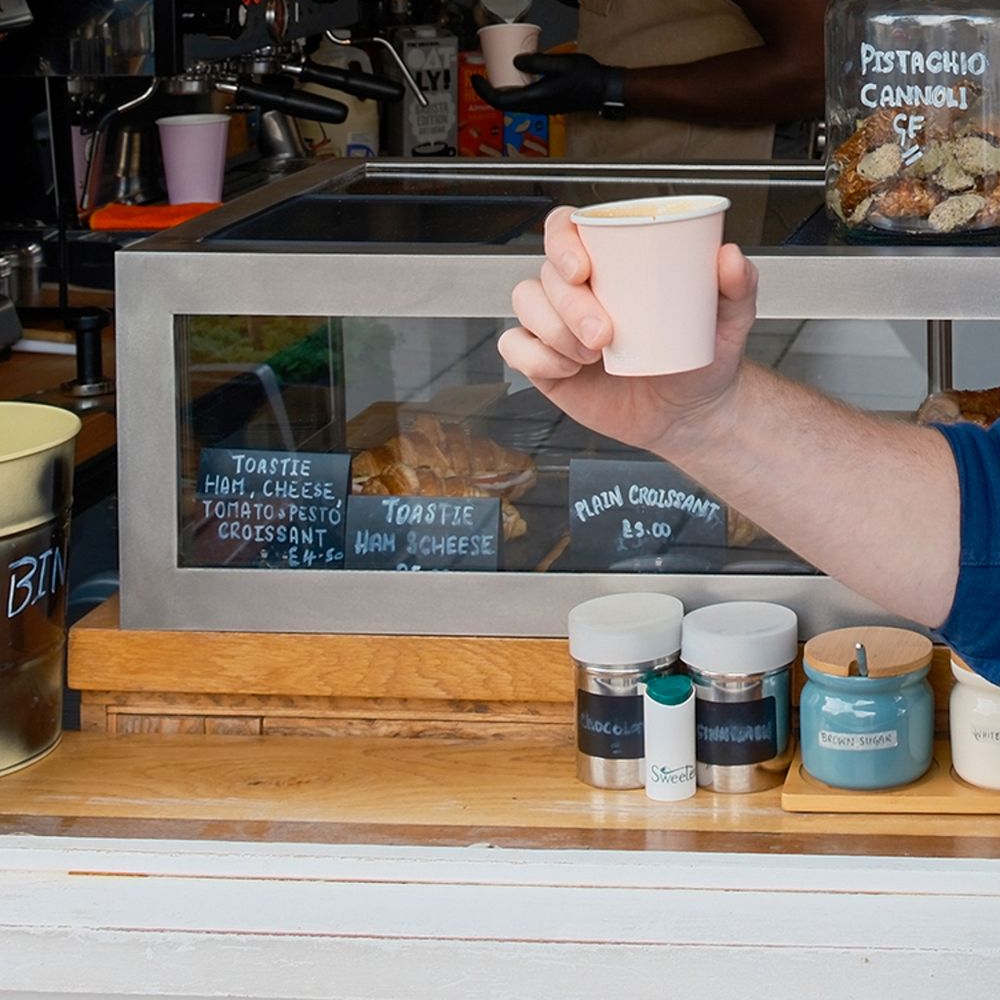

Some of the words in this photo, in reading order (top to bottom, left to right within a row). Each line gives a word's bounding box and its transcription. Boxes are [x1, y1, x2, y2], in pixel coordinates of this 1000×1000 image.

[860, 42, 988, 75] PISTACHIO
[416, 69, 450, 91] LY!
[860, 83, 968, 109] CANNOLI
[232, 454, 312, 477] TOASTIE
[202, 500, 274, 520] TOMATO
[289, 503, 341, 525] PESTO
[382, 497, 474, 526] TOASTIE
[574, 485, 624, 522] PLAIN
[628, 484, 721, 522] CROISSANT
[218, 521, 327, 547] CROISSANT
[354, 529, 396, 555] HAM
[418, 534, 496, 556] CHEESE
[821, 732, 855, 747] BROWN
[859, 735, 893, 746] SUGAR
